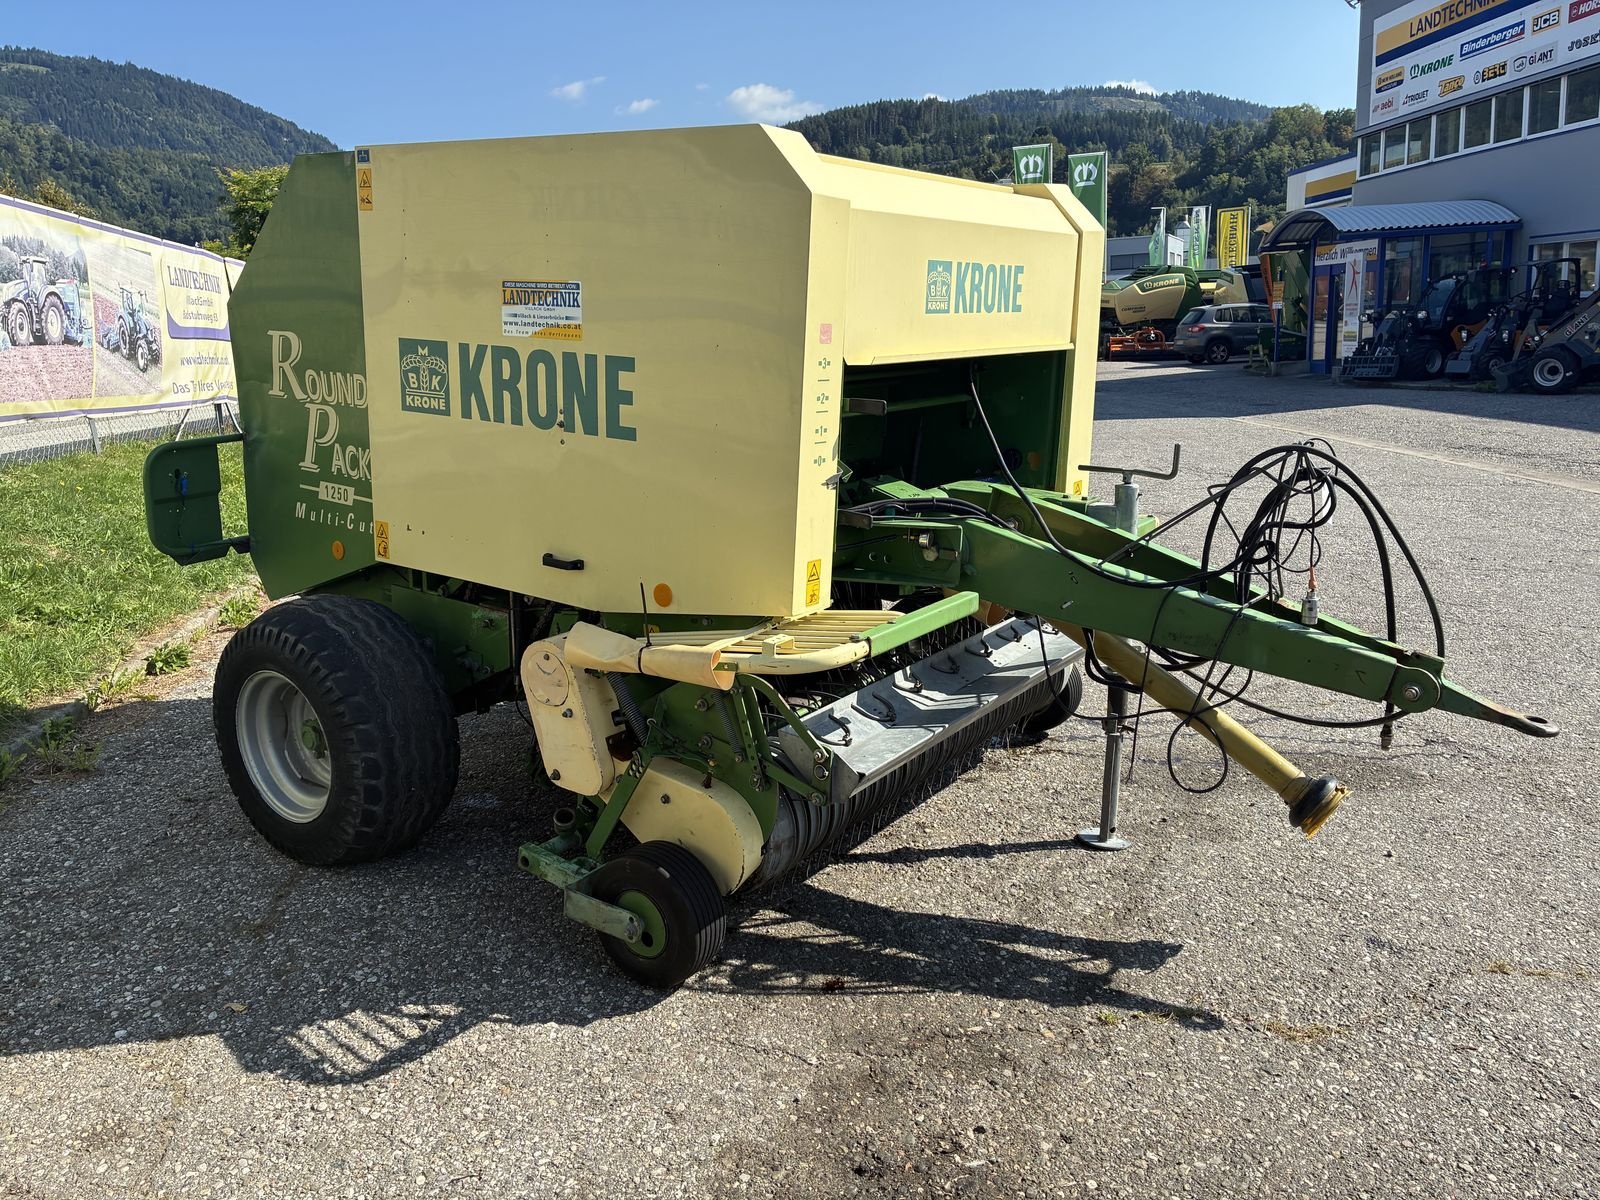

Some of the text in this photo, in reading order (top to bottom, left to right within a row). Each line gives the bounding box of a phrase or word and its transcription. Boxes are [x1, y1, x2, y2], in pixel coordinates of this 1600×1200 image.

[1533, 11, 1560, 31] JCB
[1462, 24, 1524, 55] Binderberger
[1568, 29, 1600, 51] JOSK
[1419, 54, 1455, 77] KRONE
[1380, 97, 1394, 111] aebi
[1315, 248, 1339, 262] Herzlich
[930, 285, 948, 297] B K
[954, 261, 1025, 314] KRONE
[1152, 278, 1180, 288] KRONE
[502, 289, 581, 308] LANDTECHNIK
[927, 301, 949, 310] KRONE
[503, 320, 581, 330] www.landtechnik.co.at
[418, 345, 429, 357] M
[172, 382, 191, 394] Das
[408, 372, 441, 391] B K
[458, 342, 637, 442] KRONE
[406, 395, 446, 411] KRONE
[324, 485, 349, 503] 1250
[295, 502, 374, 534] Multi-Cut
